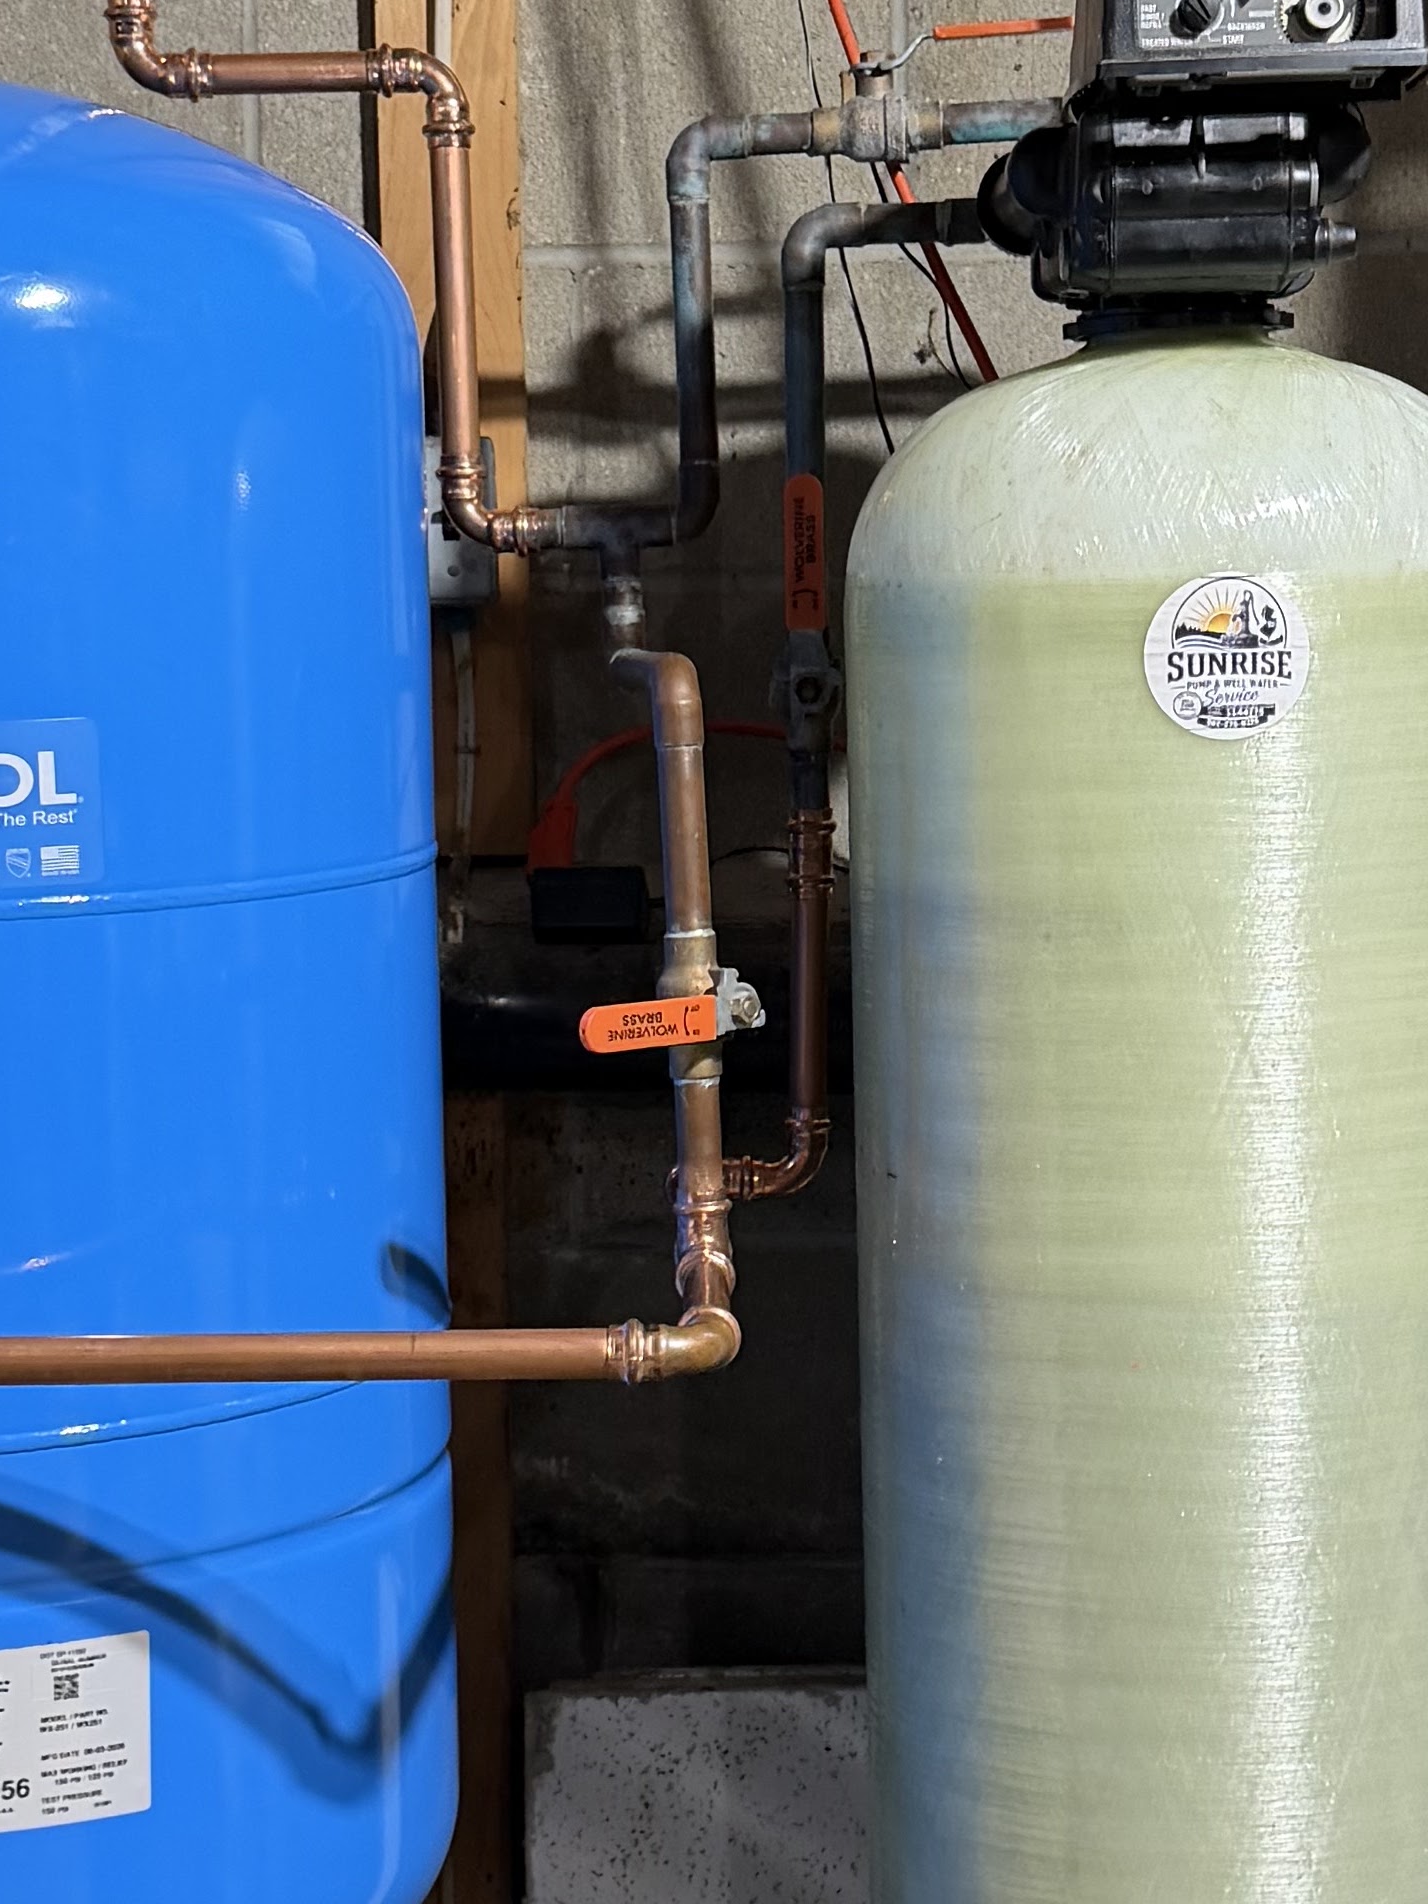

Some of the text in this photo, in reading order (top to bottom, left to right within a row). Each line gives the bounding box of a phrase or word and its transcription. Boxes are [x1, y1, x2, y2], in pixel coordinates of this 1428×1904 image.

[794, 496, 806, 584] WOLVERINE
[805, 514, 817, 564] BRASS
[1167, 650, 1293, 684] SUNRISE
[1187, 680, 1212, 690] PUMP
[1223, 680, 1247, 689] WELL
[1250, 680, 1278, 689] WATER
[1203, 689, 1260, 707] Service
[33, 810, 75, 825] Rest
[622, 1011, 663, 1027] BRASS
[608, 1024, 679, 1043] WOLVERINE
